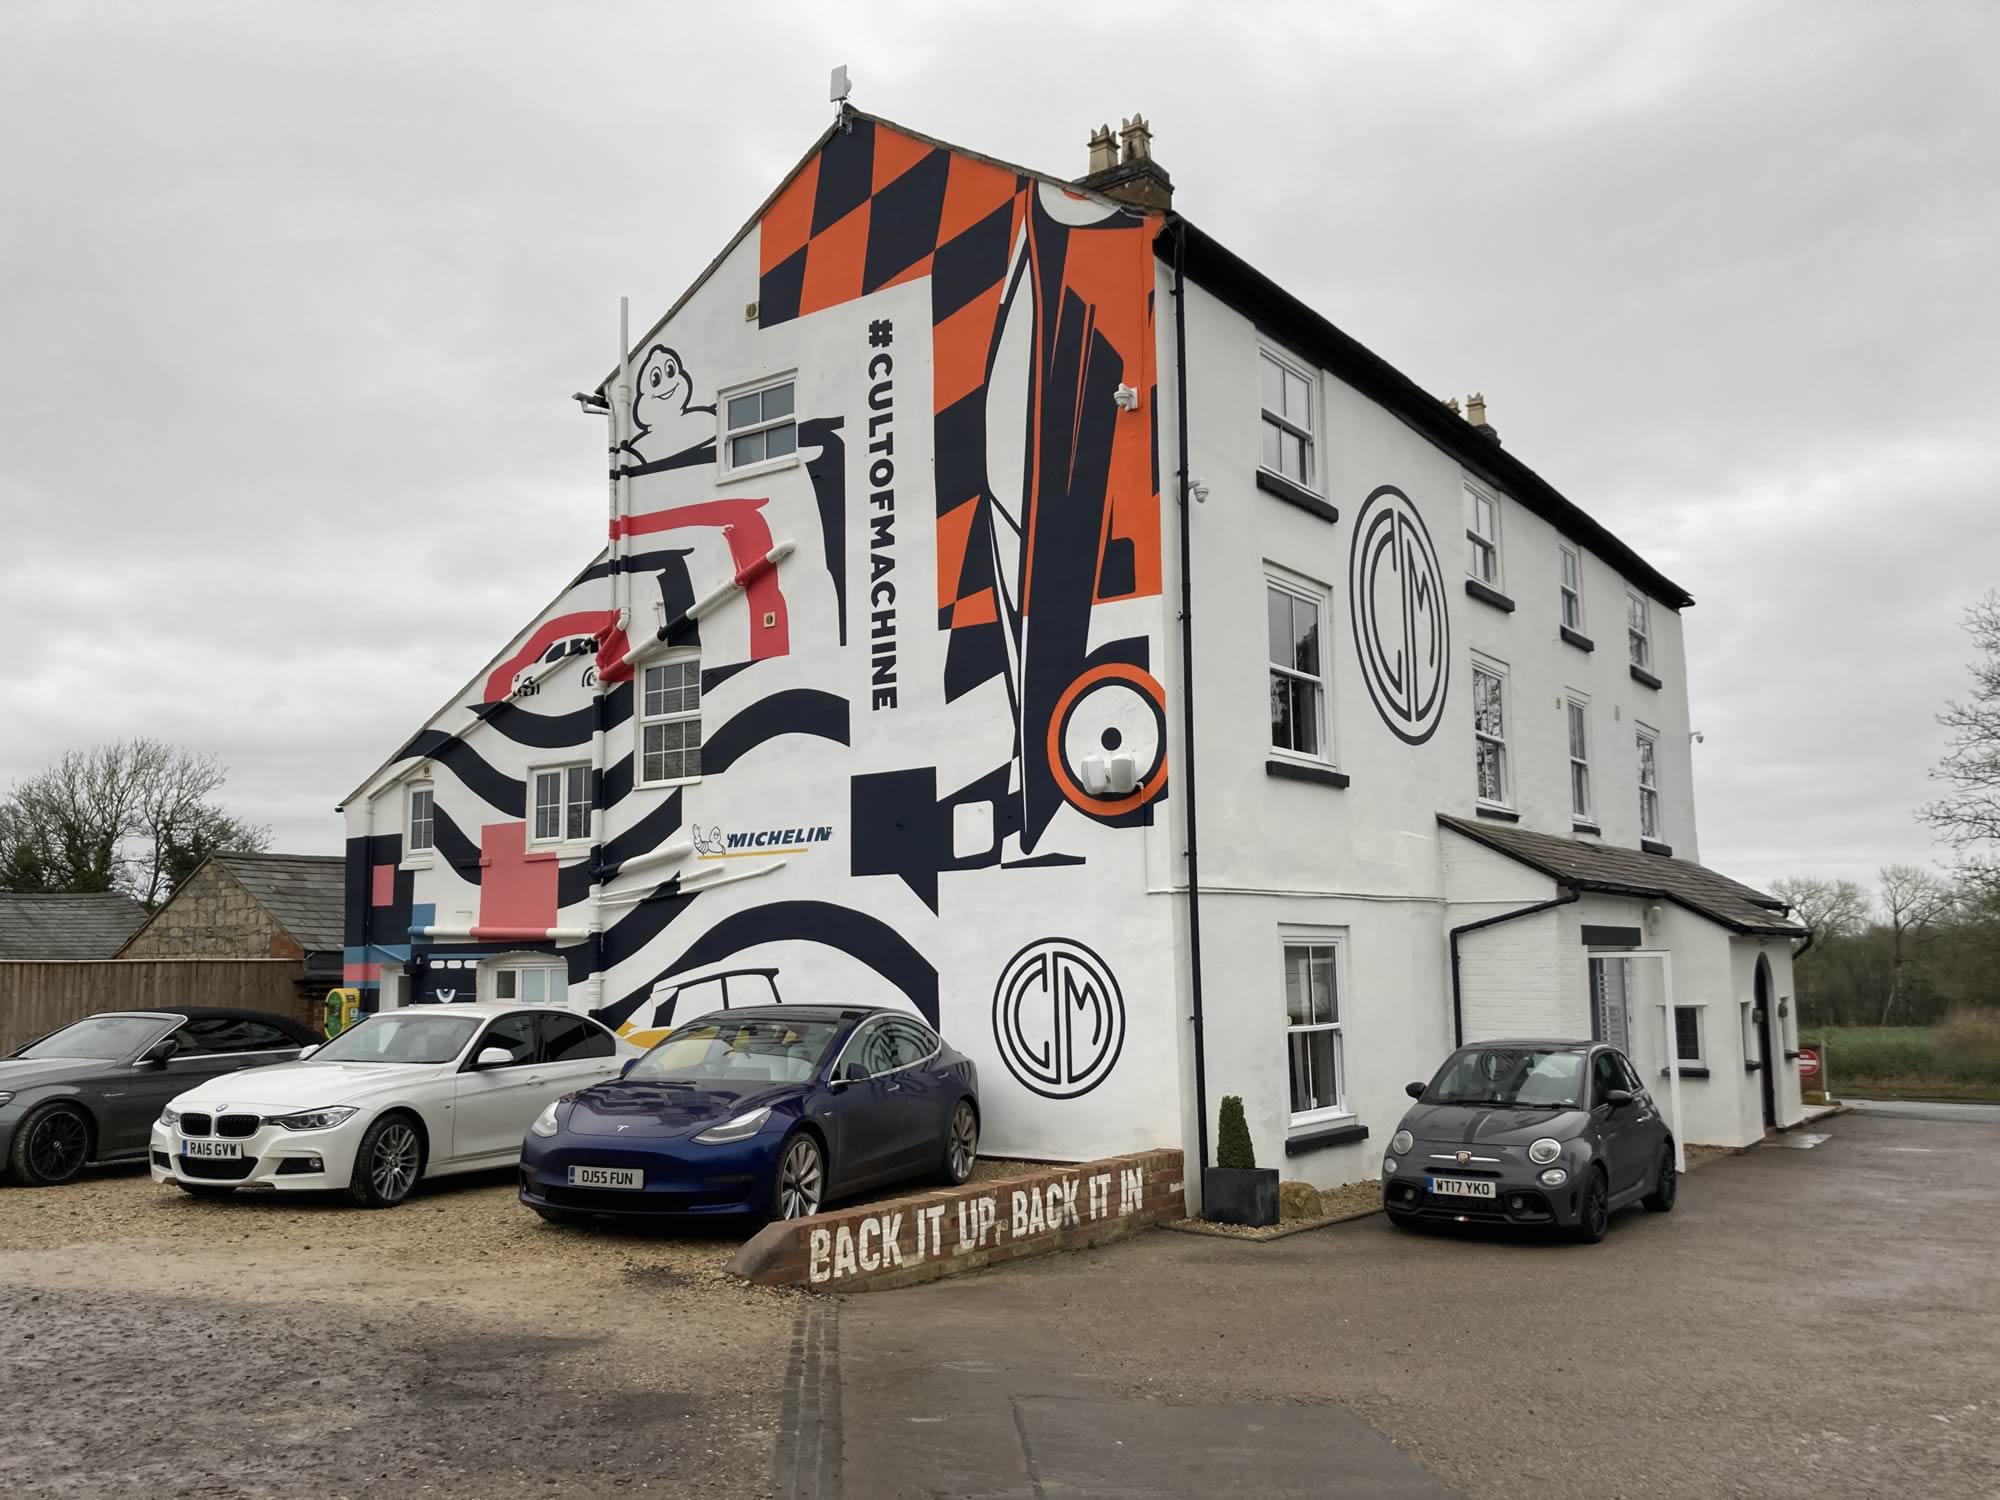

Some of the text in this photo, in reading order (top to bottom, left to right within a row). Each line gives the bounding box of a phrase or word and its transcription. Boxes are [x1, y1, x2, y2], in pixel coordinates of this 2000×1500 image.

[868, 318, 898, 711] #CULTOFMACHINE
[727, 826, 832, 848] MICHELIN
[190, 1142, 237, 1157] RA15 GVW
[582, 1169, 633, 1186] DJ55 FUN
[1436, 1180, 1462, 1193] WT17
[809, 1212, 905, 1283] BACK
[916, 1204, 945, 1260] IT
[1012, 1175, 1081, 1239] BACK
[1088, 1172, 1112, 1221] IT
[1118, 1167, 1144, 1217] IN
